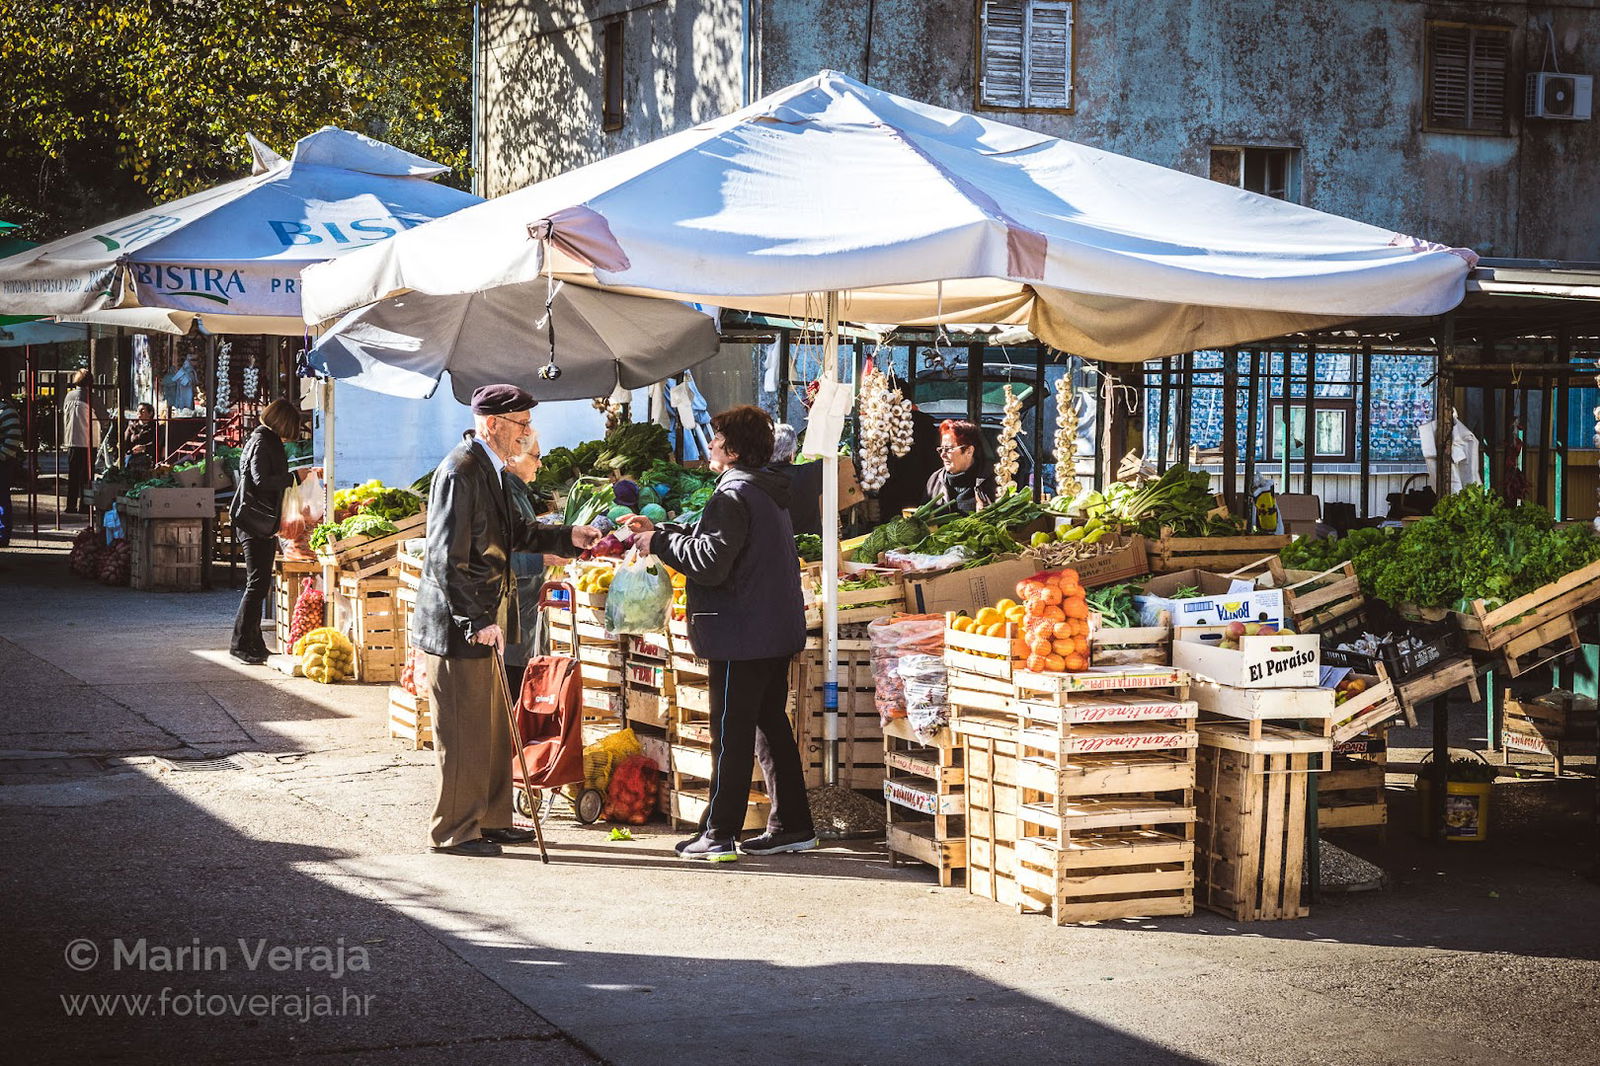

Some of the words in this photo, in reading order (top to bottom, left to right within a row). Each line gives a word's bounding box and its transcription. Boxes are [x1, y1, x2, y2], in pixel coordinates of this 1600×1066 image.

[137, 262, 246, 299] BISTRA
[1215, 601, 1250, 621] BONITA
[1248, 662, 1264, 682] El
[1266, 650, 1315, 676] Paraiso
[1080, 703, 1183, 721] Fantinelli
[1076, 735, 1183, 752] Fantinelli
